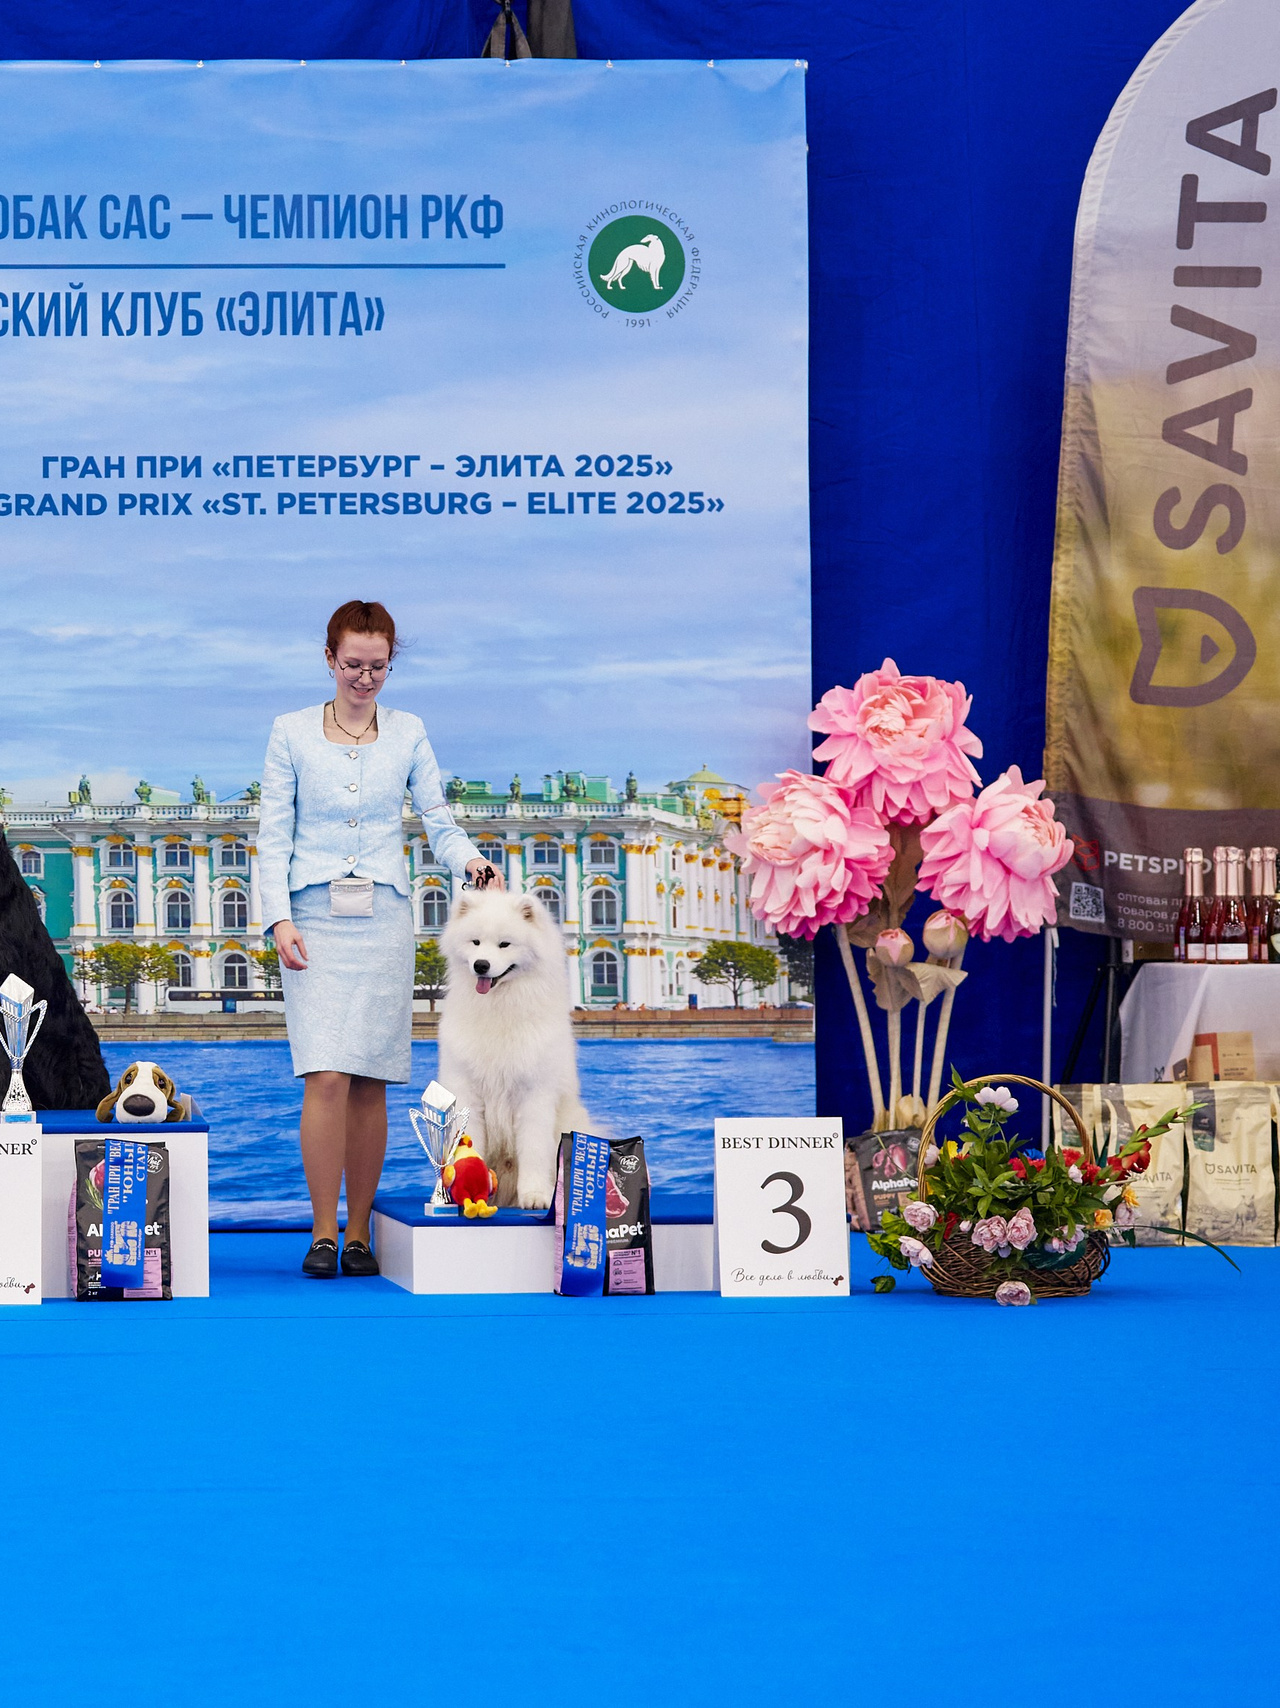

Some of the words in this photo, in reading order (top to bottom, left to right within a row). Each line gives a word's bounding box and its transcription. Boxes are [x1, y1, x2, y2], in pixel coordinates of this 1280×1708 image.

[223, 193, 409, 240] ЧЕМПИОН
[420, 194, 504, 240] РКФ
[586, 200, 695, 242] КИНОЛОГИЧЕСКАЯ
[573, 234, 610, 319] РОССИЙСКАЯ
[666, 246, 702, 319] ФЕДЕРАЦИЯ
[101, 291, 204, 337] КЛУБ
[215, 290, 385, 337] «ЭЛИТА»
[625, 318, 651, 328] 1991
[1153, 86, 1278, 554] SAVITA
[42, 455, 125, 479] ГРАН
[136, 455, 202, 479] ПРИ
[212, 455, 421, 478] «ПЕТЕРБУРГ
[455, 454, 565, 478] ЭЛИТА
[574, 454, 673, 478] 2025»
[118, 493, 193, 516] PRIX
[202, 492, 267, 516] «ST.
[277, 492, 492, 516] PETERSBURG
[527, 491, 617, 515] ELITE
[626, 491, 725, 515] 2025»
[1128, 919, 1154, 931] 800
[722, 1137, 764, 1149] BEST
[109, 1166, 120, 1184] ПРИ
[136, 1143, 147, 1182] СТАР
[1216, 1163, 1258, 1174] SAVITA
[573, 1168, 585, 1186] ПРИ
[760, 1171, 812, 1255] 3
[730, 1267, 756, 1283] Все
[758, 1274, 784, 1287] дело
